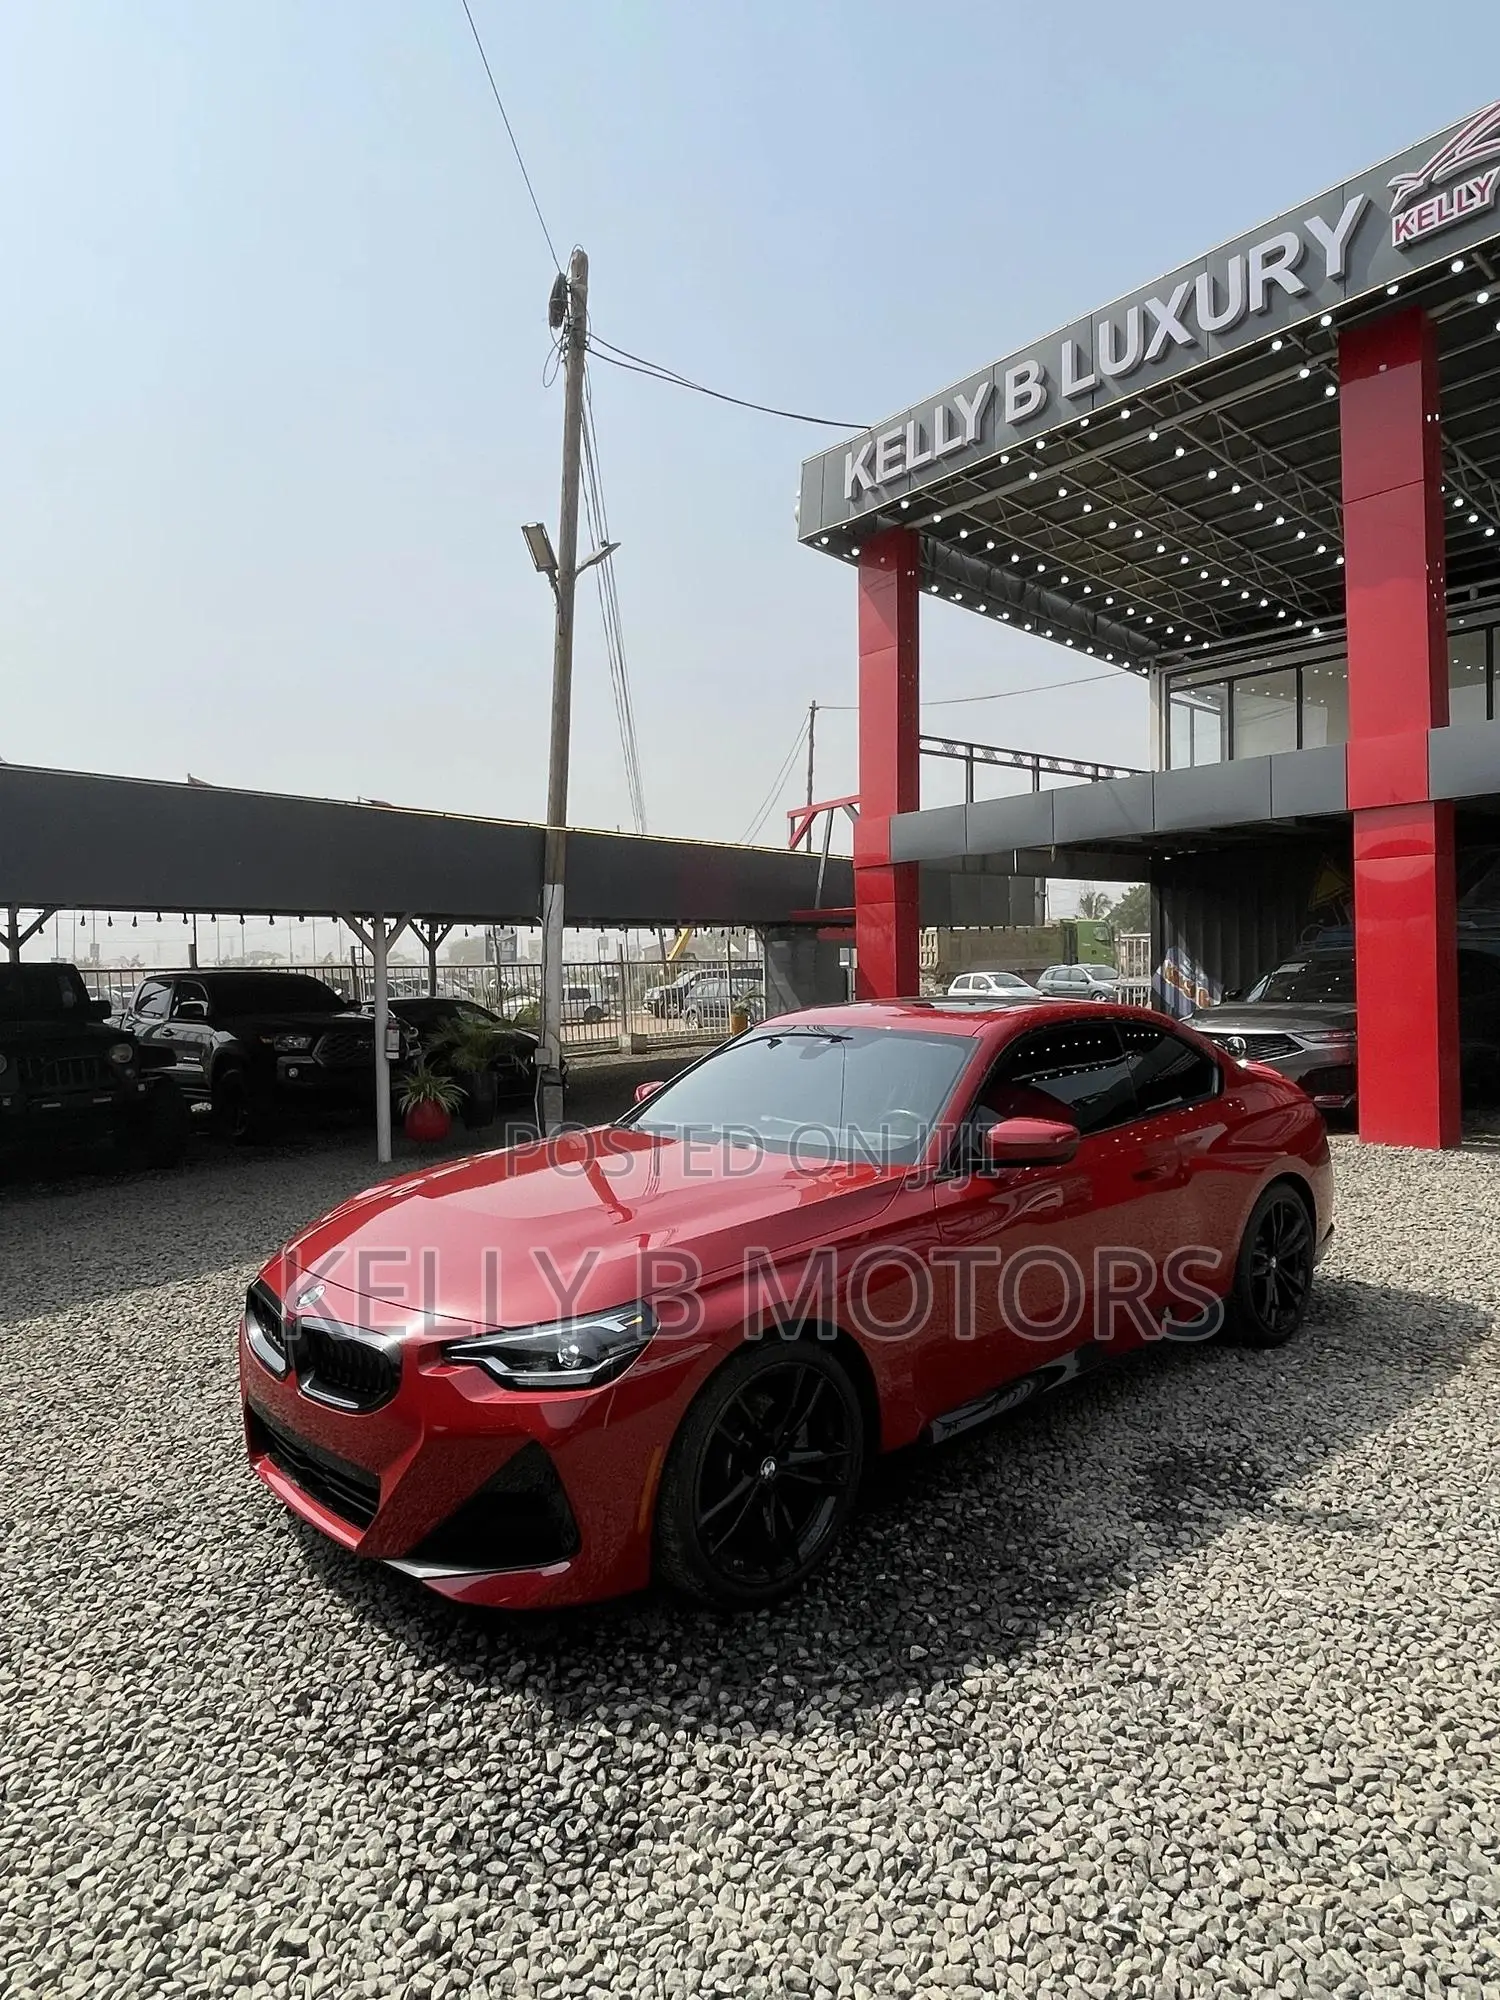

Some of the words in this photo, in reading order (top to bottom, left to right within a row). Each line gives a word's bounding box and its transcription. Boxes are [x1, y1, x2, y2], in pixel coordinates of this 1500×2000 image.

[1392, 169, 1498, 246] KELLY
[844, 381, 994, 499] KELLY
[1004, 359, 1046, 424] B
[1060, 194, 1371, 399] LUXURY
